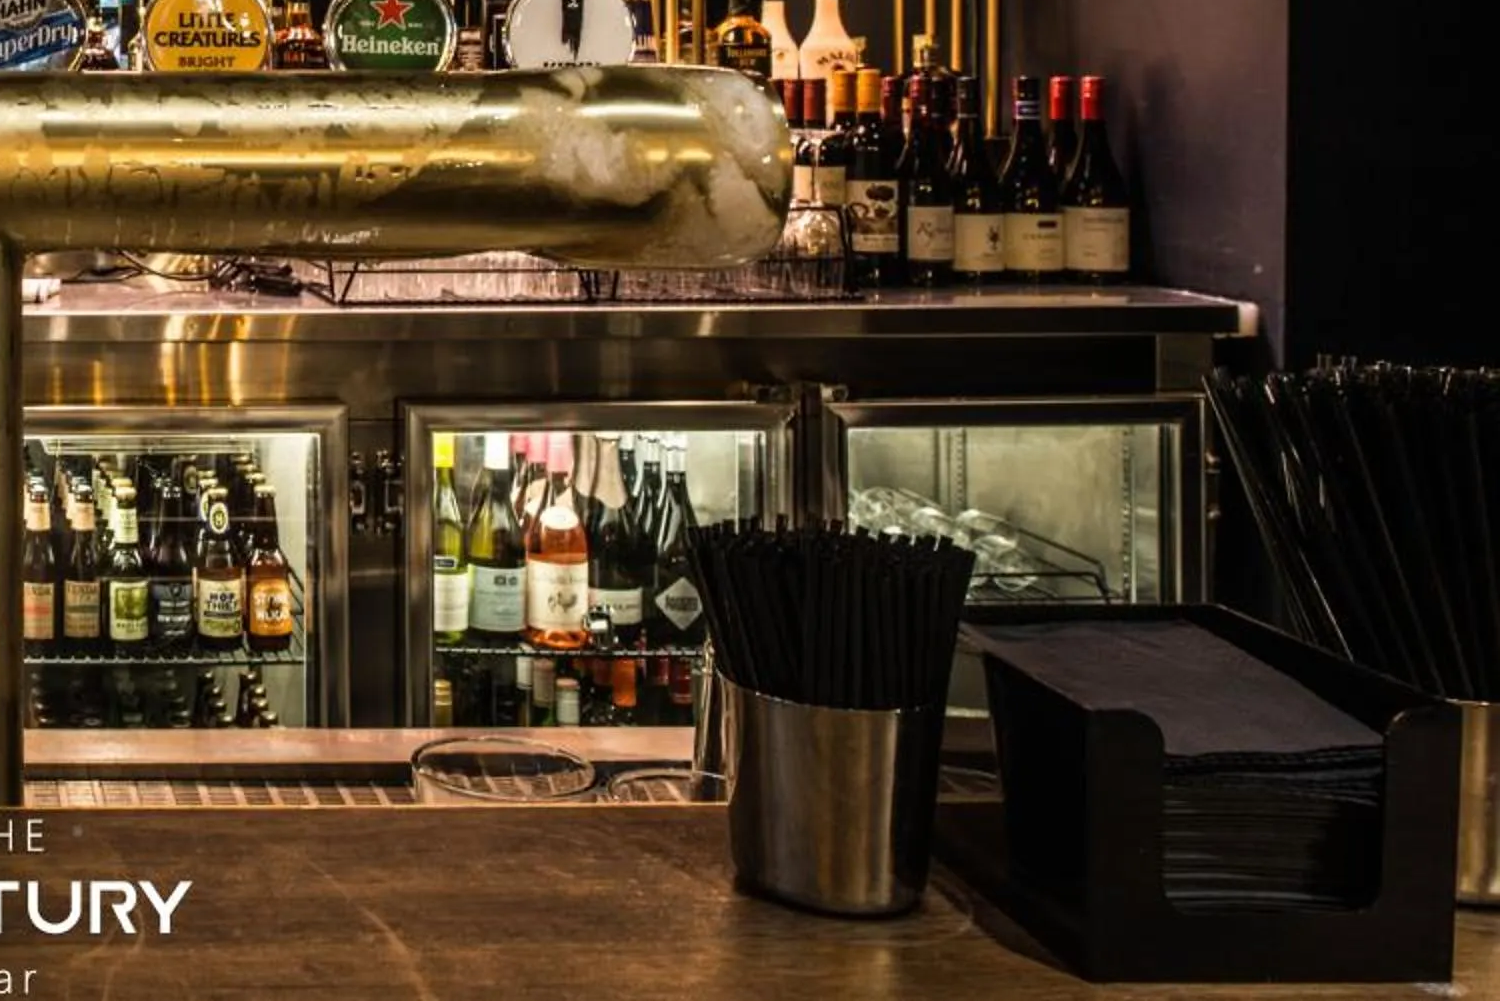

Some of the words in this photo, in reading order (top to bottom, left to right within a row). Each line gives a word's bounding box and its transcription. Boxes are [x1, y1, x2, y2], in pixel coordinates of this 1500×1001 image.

[154, 30, 261, 48] CREATURES
[341, 34, 439, 56] Heineken
[178, 56, 236, 68] BRIGHT
